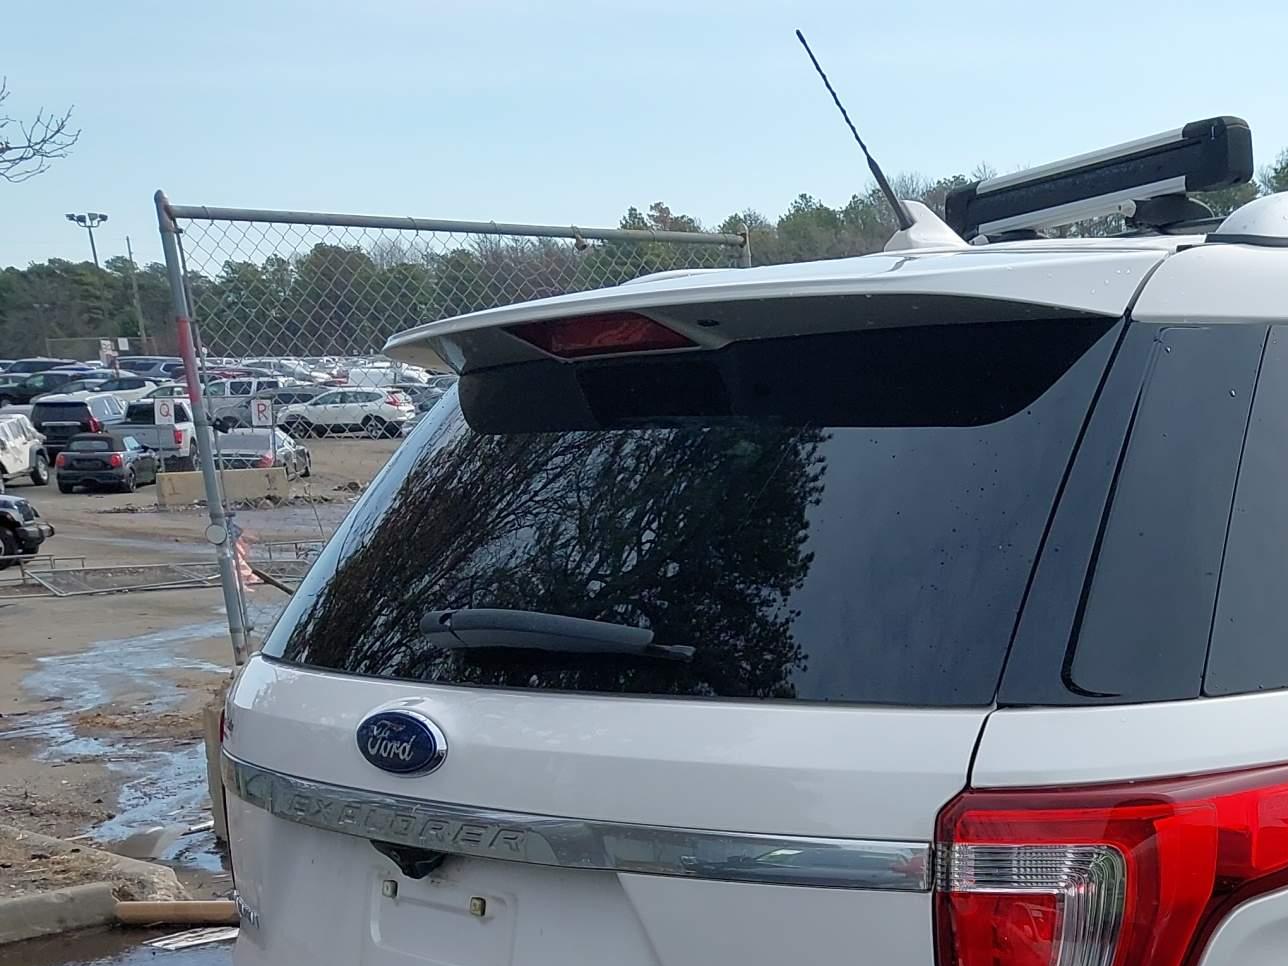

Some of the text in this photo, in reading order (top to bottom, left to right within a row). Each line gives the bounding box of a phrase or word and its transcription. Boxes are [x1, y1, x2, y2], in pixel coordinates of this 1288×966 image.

[159, 403, 173, 418] Q
[256, 403, 269, 421] R
[367, 719, 417, 761] Ford
[287, 793, 529, 852] EXPLORER
